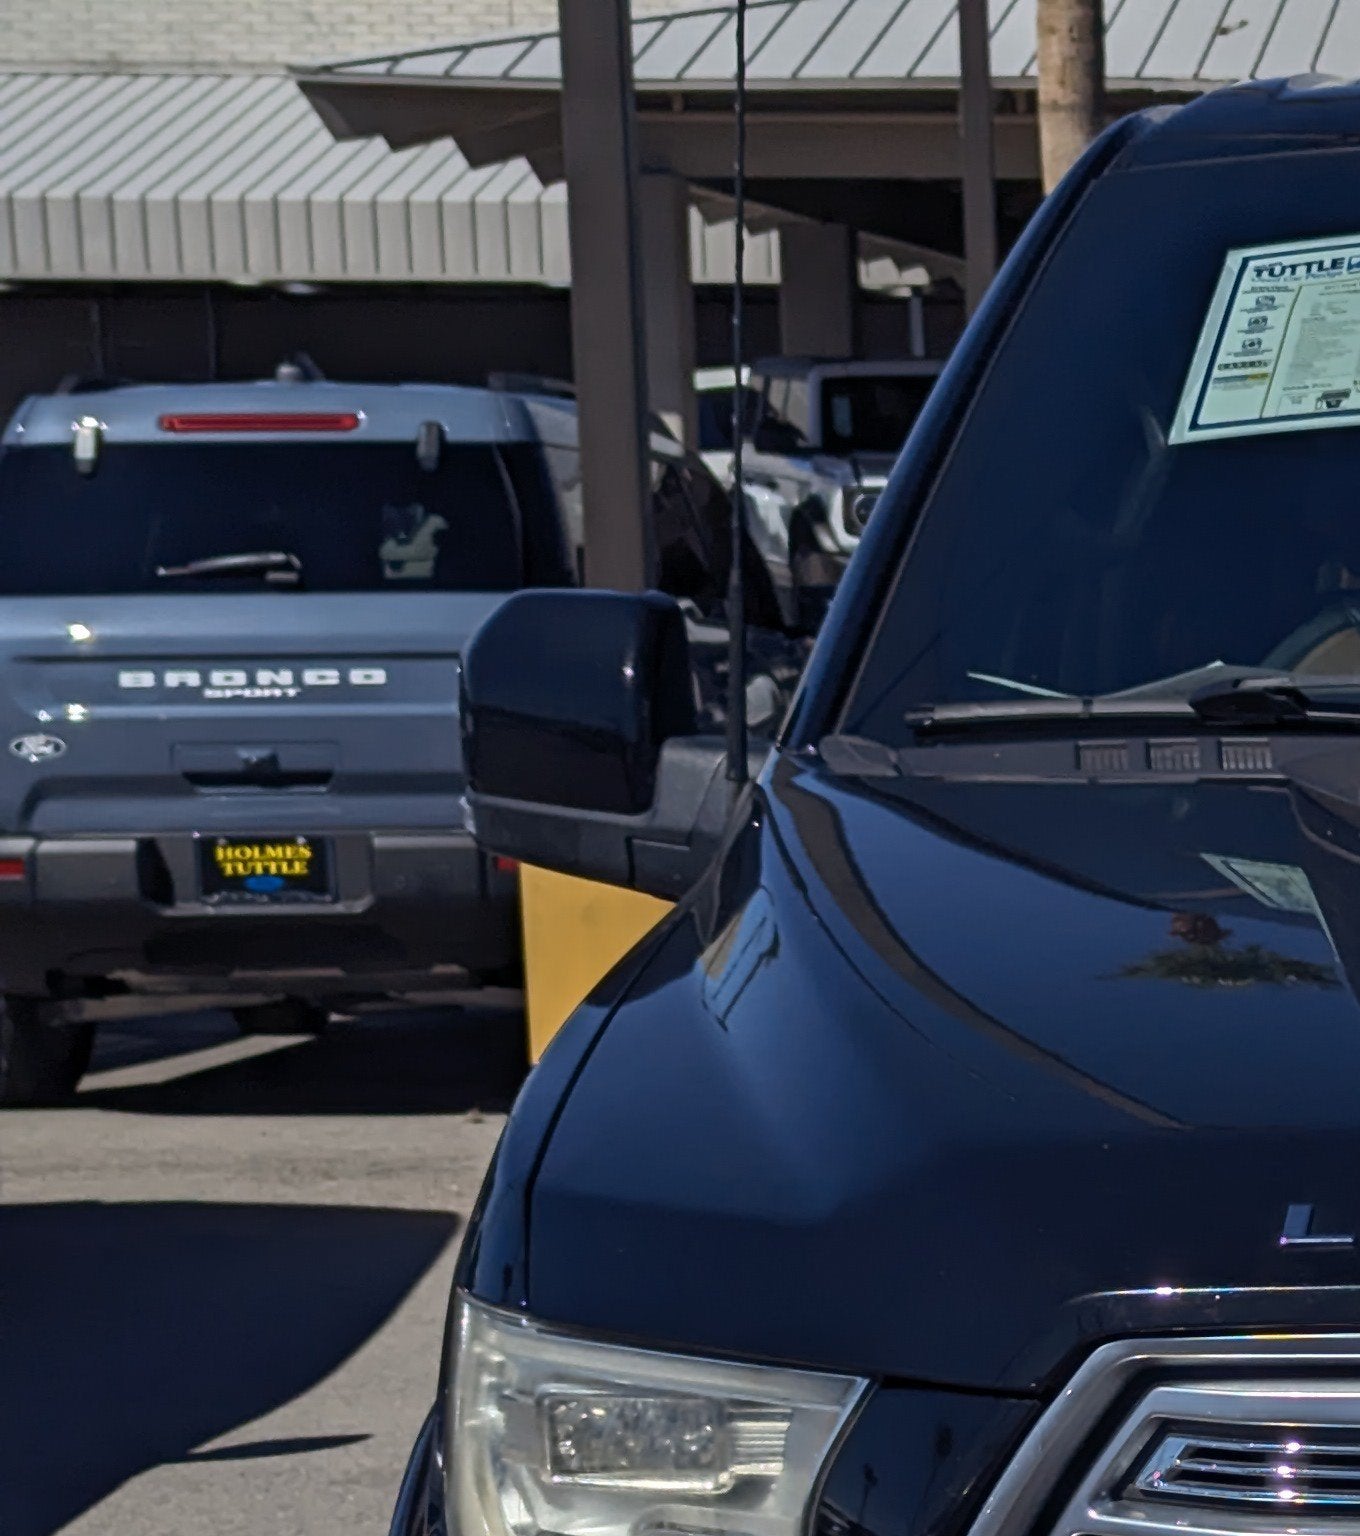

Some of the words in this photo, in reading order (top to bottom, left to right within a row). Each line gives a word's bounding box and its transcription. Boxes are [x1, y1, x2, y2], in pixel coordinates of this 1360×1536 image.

[1254, 257, 1345, 278] TUTTLE
[118, 668, 387, 688] BRONCO
[203, 688, 300, 698] SPORT
[215, 843, 312, 861] HOLMES
[221, 860, 310, 877] TUTTLE
